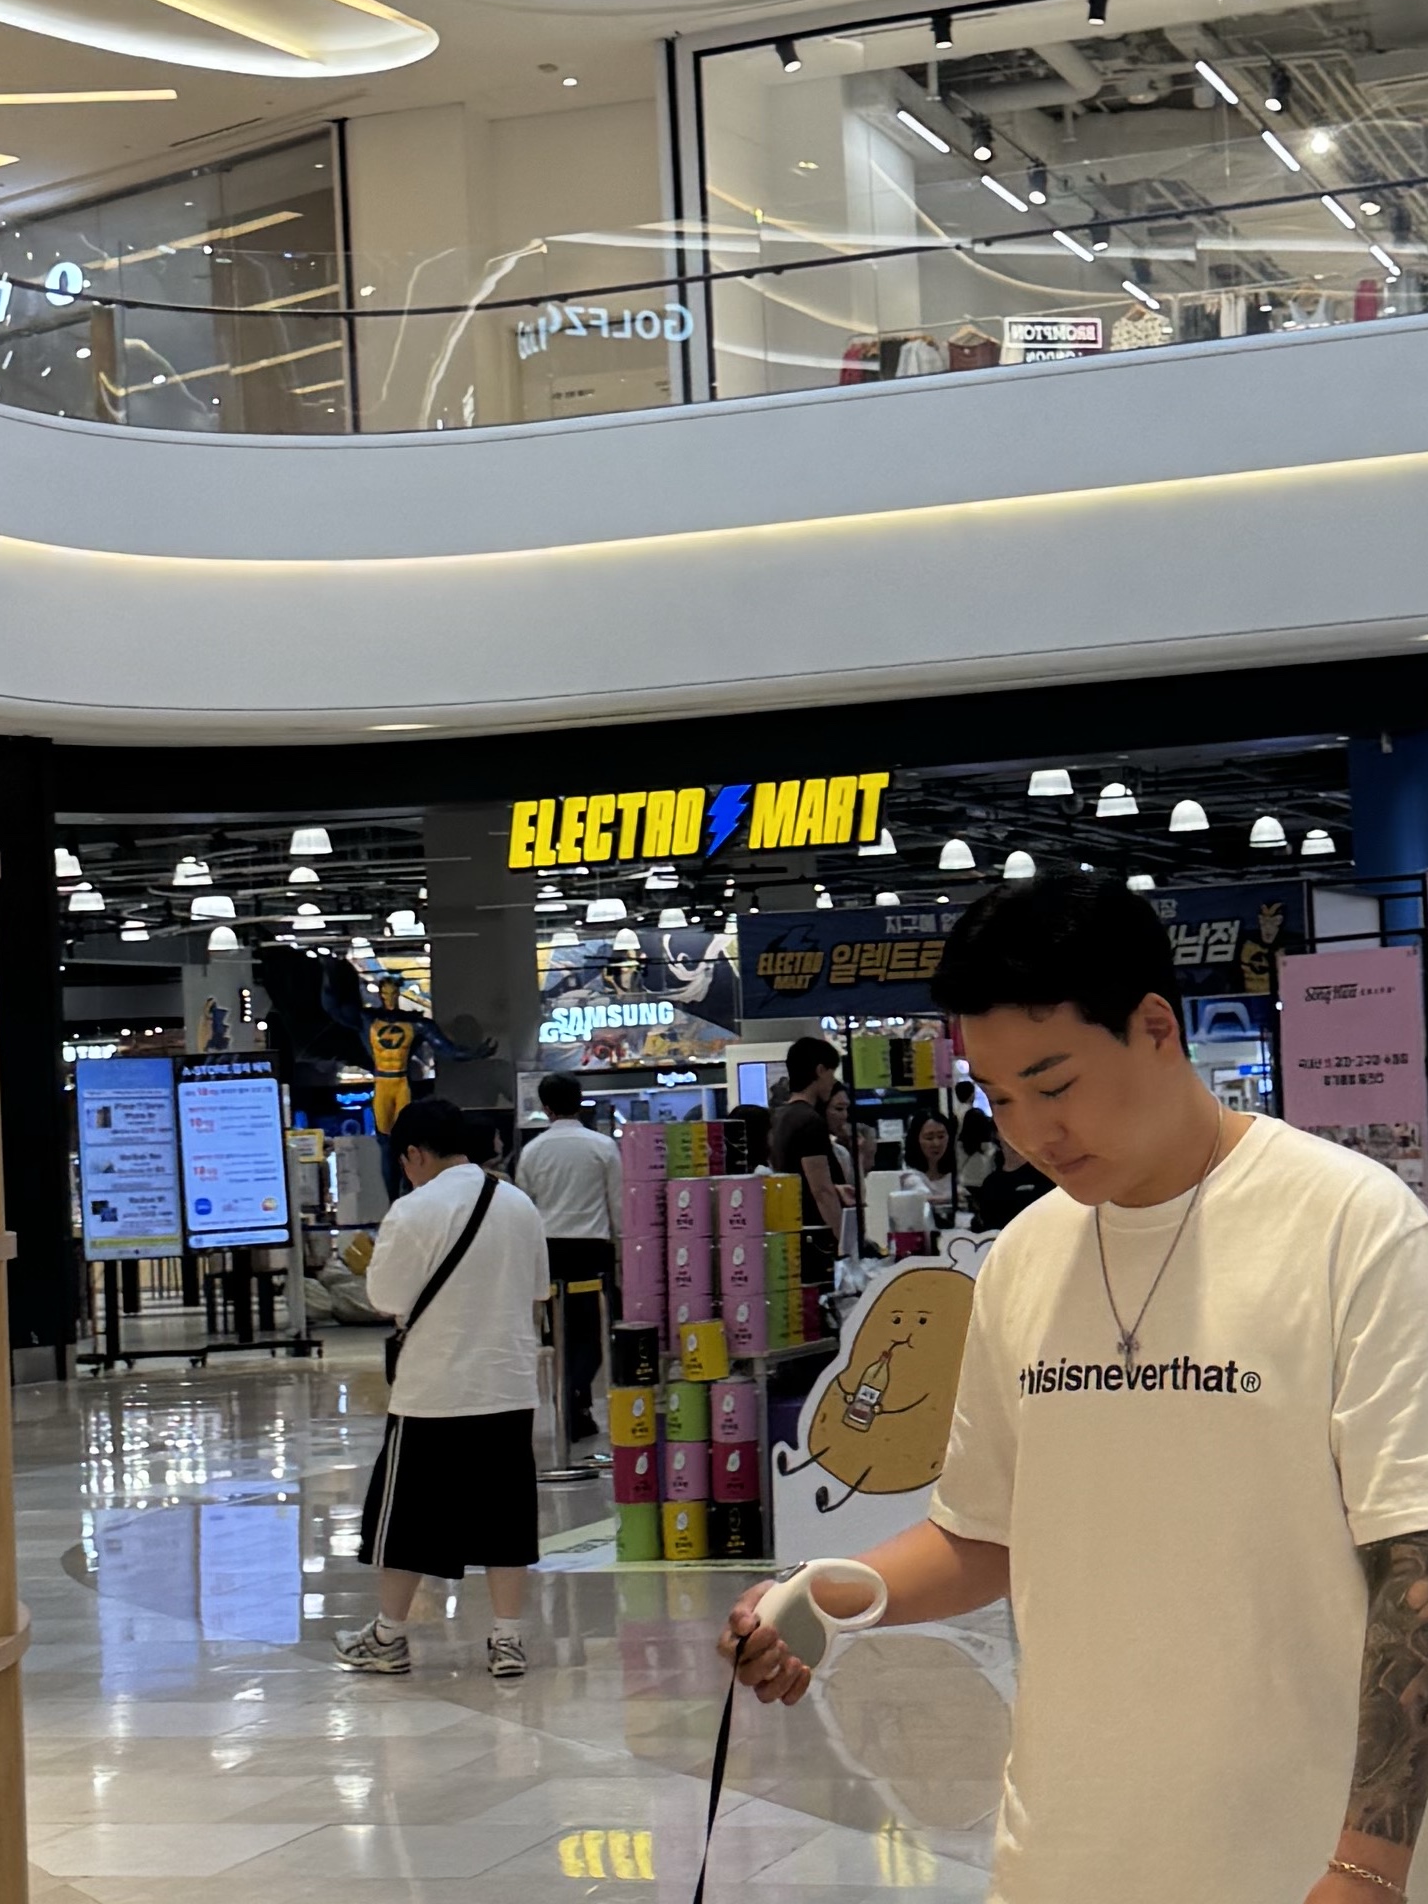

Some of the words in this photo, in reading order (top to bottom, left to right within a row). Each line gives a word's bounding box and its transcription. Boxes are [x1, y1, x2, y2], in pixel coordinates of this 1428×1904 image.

[507, 787, 706, 869] ELECTRO
[748, 771, 890, 850] MART
[551, 1001, 675, 1029] SAMSUNG
